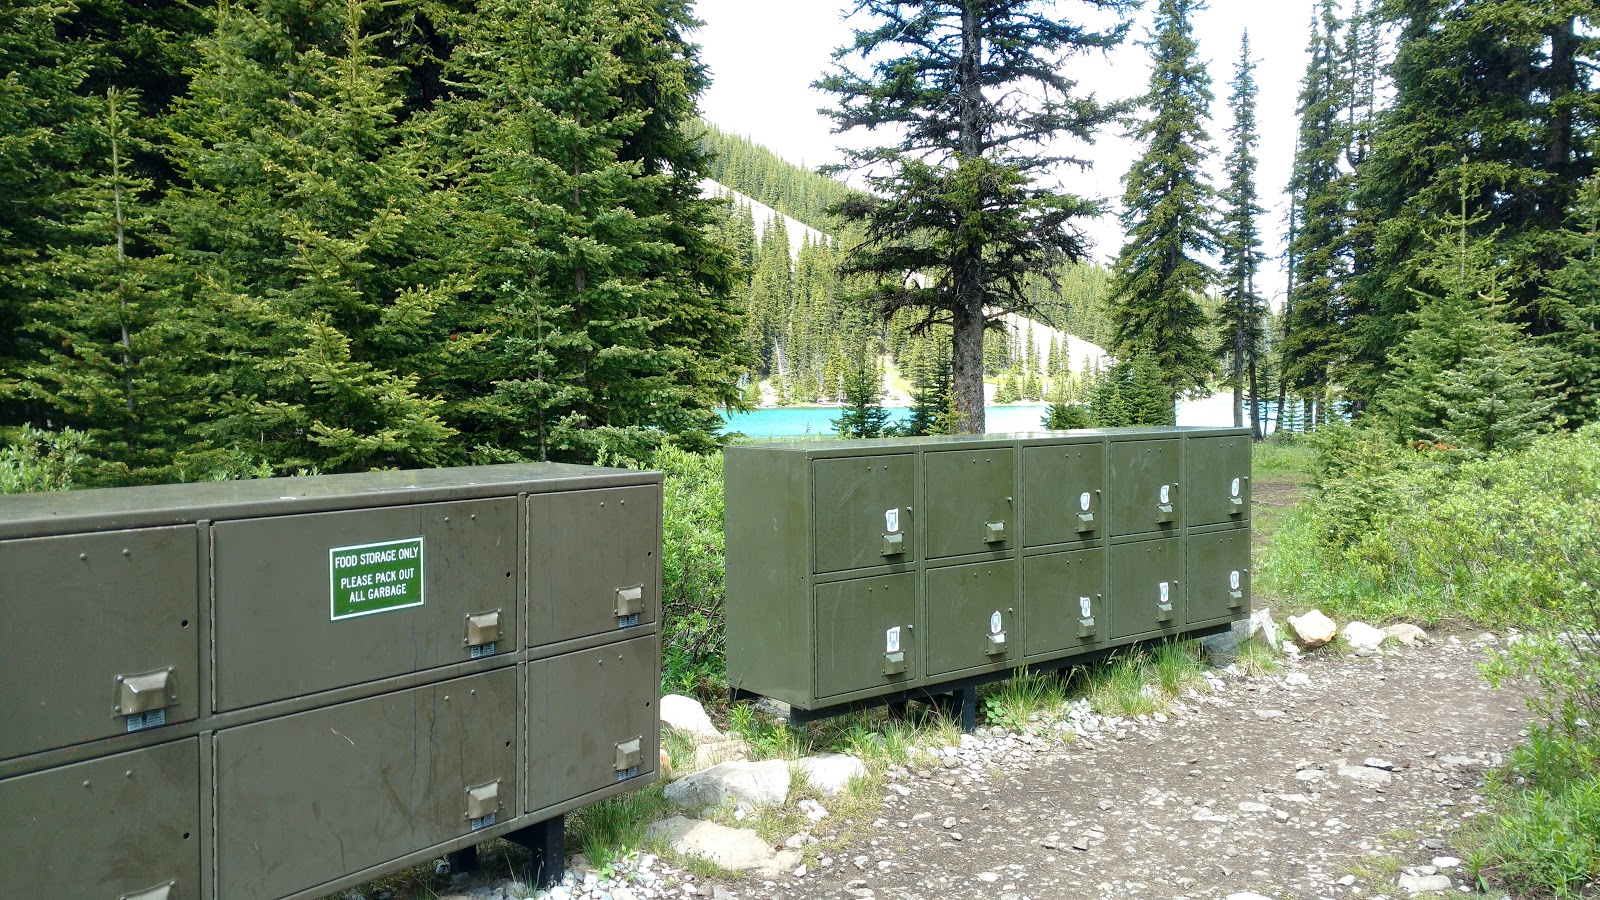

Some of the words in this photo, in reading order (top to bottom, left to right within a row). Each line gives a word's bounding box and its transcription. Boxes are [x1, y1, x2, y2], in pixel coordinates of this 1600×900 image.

[335, 555, 357, 568] FOOD
[360, 550, 396, 565] STORAGE
[398, 547, 418, 560] ONLY
[341, 574, 373, 589] PLEASE
[375, 571, 396, 584] PACK
[399, 568, 414, 580] OUT
[349, 590, 365, 603] ALL
[368, 584, 406, 599] GARBAGE
